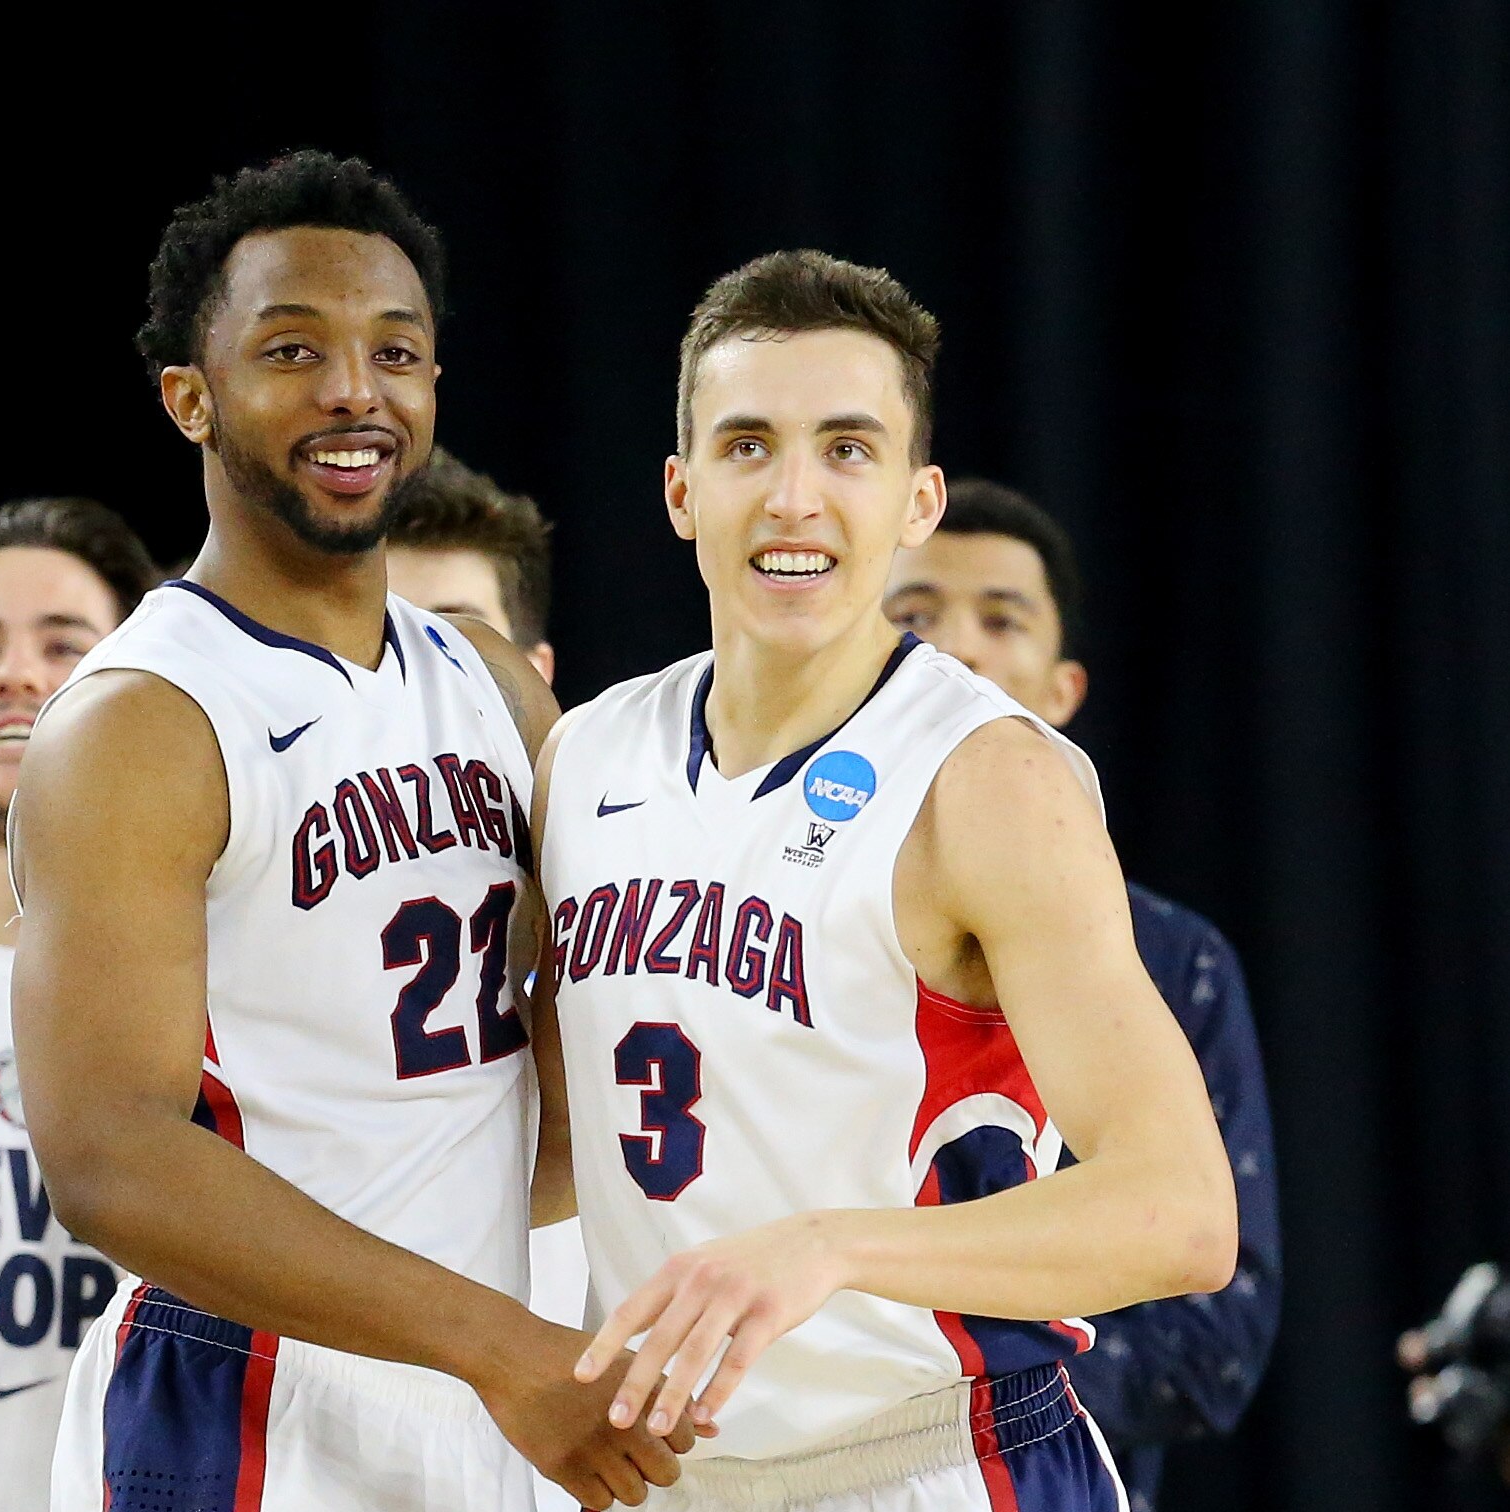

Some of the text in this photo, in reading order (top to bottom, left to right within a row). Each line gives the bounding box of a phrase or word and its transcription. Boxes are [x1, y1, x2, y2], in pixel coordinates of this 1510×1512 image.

[808, 777, 869, 808] NCAA
[380, 879, 530, 1081] 22
[553, 877, 815, 1030] GONZAGA
[614, 1021, 704, 1202] 3
